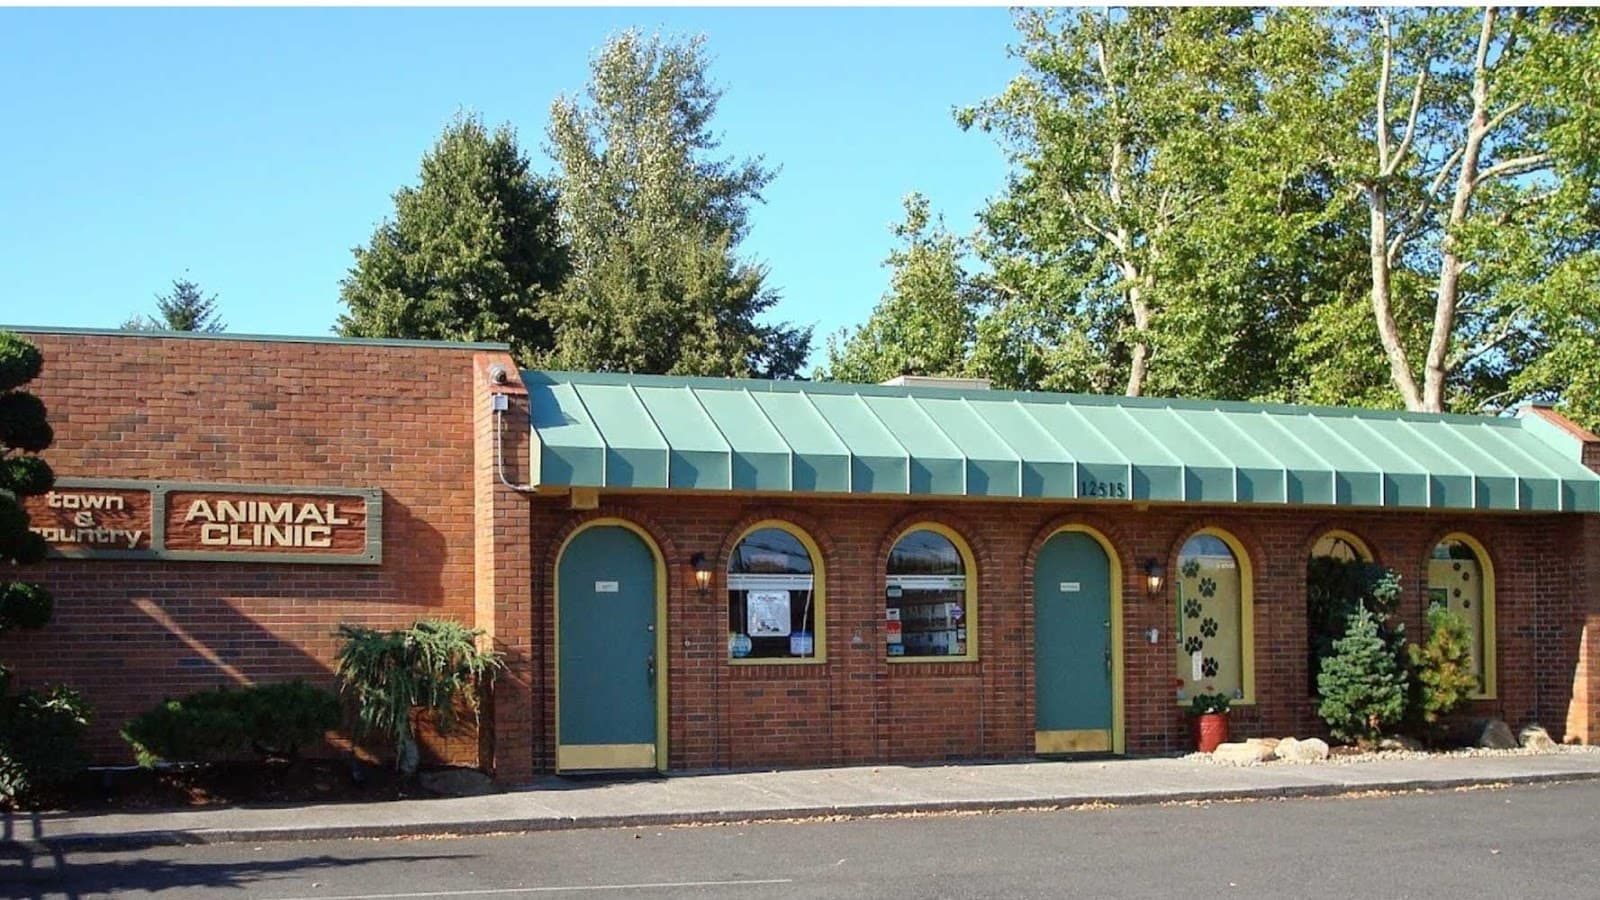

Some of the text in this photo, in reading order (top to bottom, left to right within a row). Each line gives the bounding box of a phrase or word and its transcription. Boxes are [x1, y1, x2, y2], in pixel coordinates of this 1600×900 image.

[1081, 481, 1125, 497] 12515
[48, 491, 124, 509] town
[74, 511, 96, 527] &
[185, 499, 349, 525] ANIMAL
[200, 523, 333, 547] CLINIC
